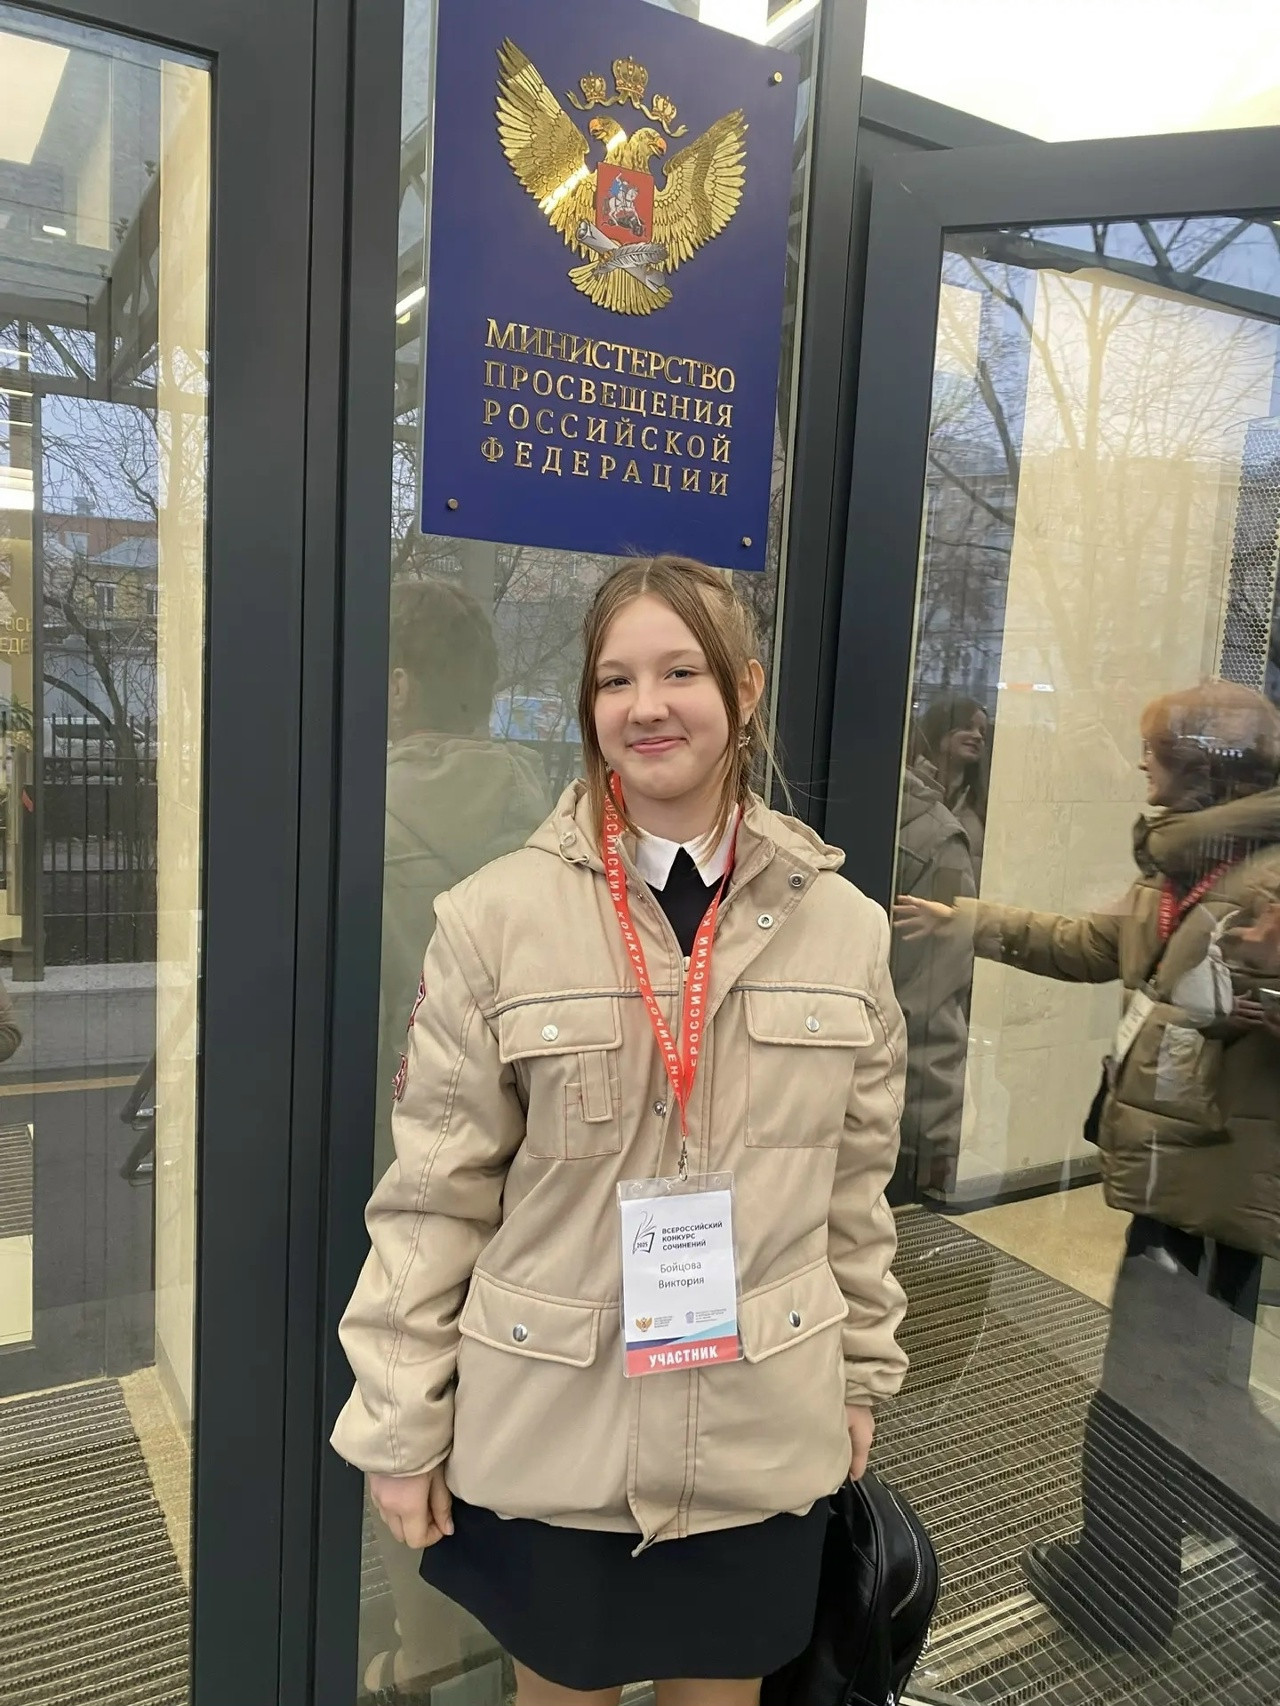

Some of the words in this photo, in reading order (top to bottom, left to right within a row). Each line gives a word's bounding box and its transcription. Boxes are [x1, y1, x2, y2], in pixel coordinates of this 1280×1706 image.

[485, 318, 735, 393] МИНИСТЕРСТВО
[483, 360, 733, 428] ПРОСВЕЩЕНИЯ
[482, 398, 731, 463] РОССИЙСКОЙ
[480, 436, 728, 496] ФЕДЕРАЦИИ
[617, 910, 647, 986] КОНКУРС
[661, 1220, 723, 1235] ВСЕРОССИЙСКИЙ
[662, 1233, 696, 1243] КОНКУРС
[662, 1239, 707, 1251] СОЧИНЕНИЙ
[660, 1261, 702, 1274] Бойцова
[658, 1277, 705, 1289] Виктория
[649, 1345, 718, 1368] УЧАСТНИК
